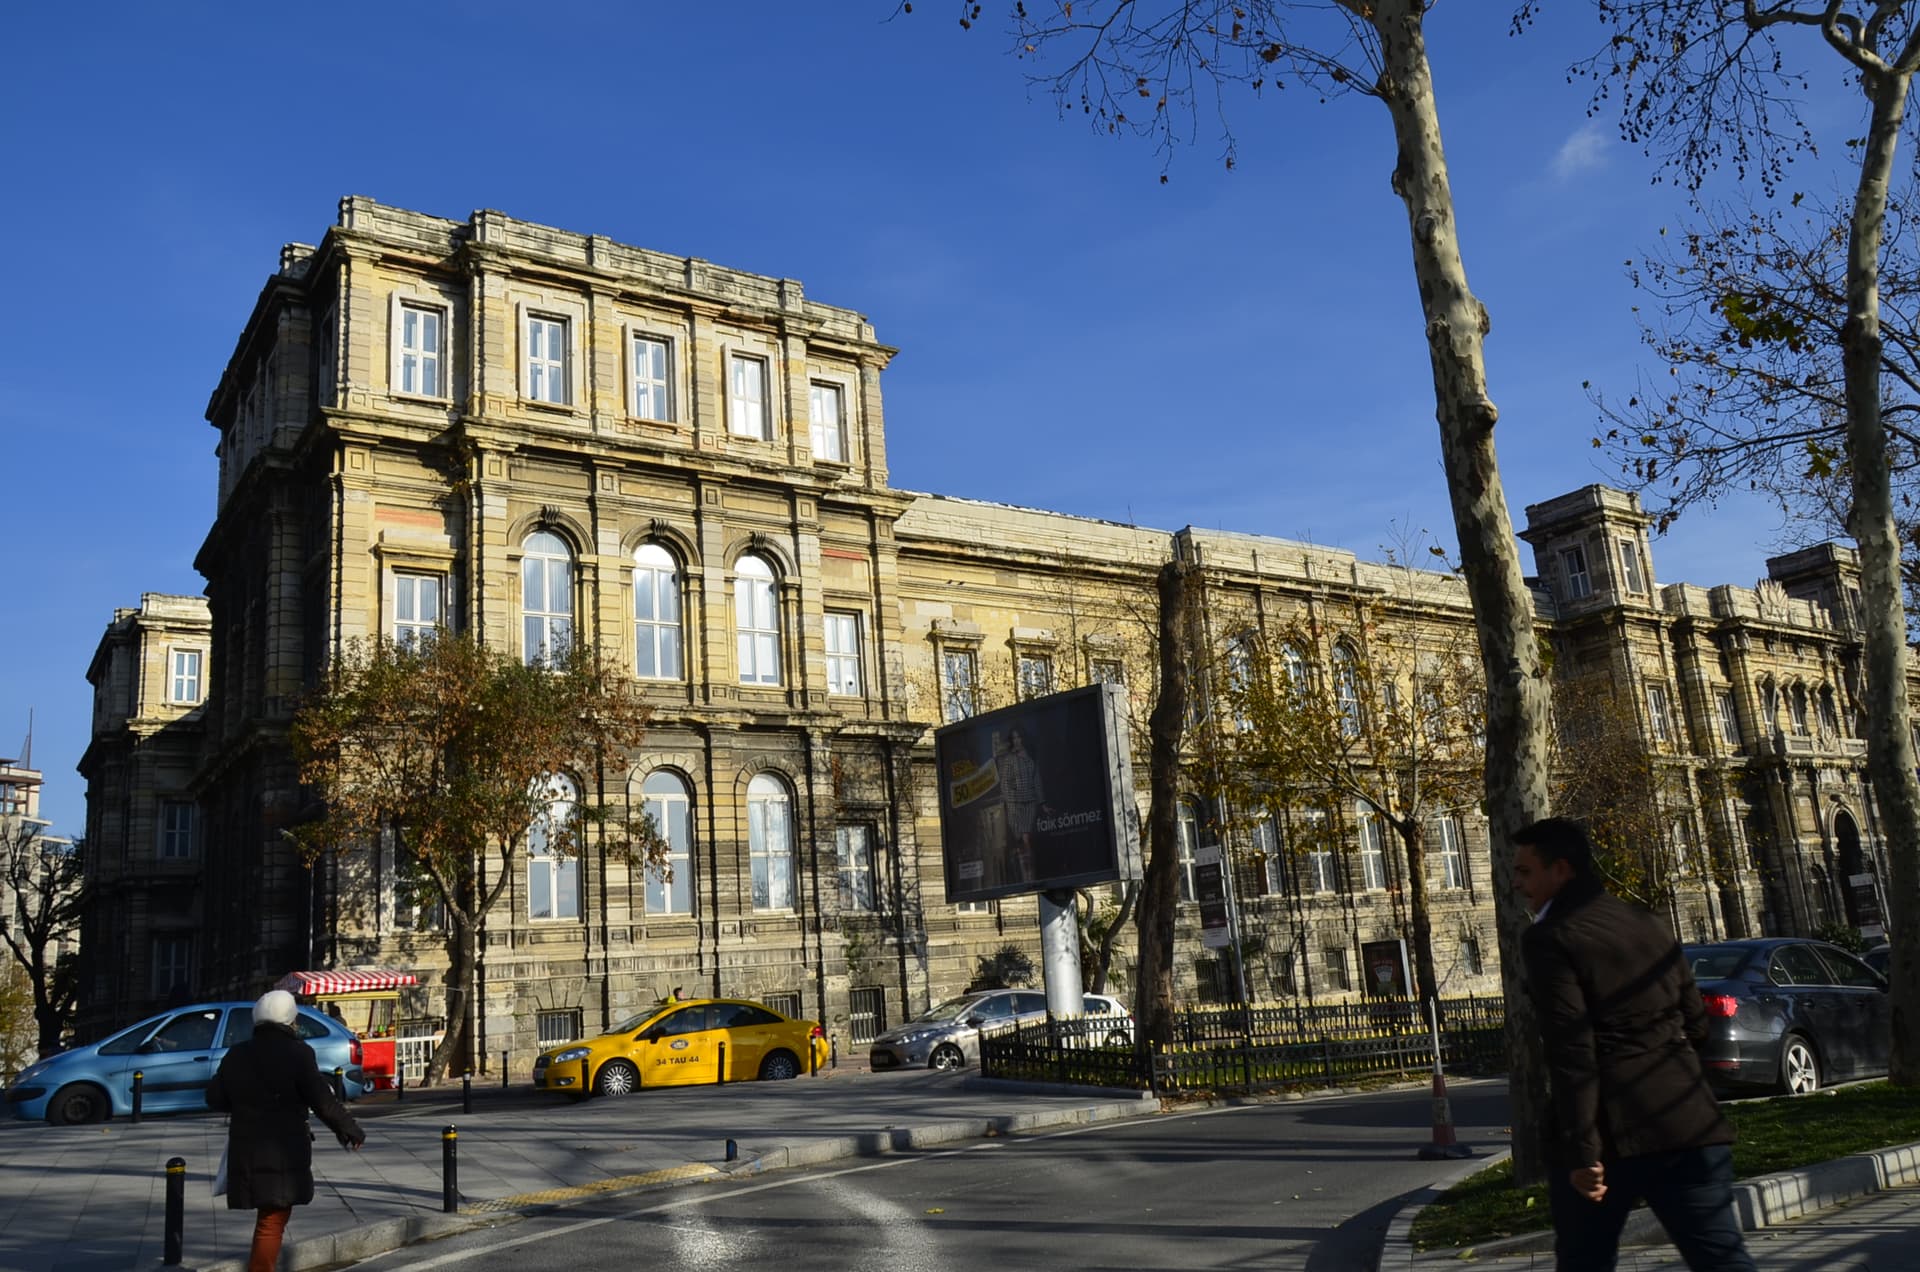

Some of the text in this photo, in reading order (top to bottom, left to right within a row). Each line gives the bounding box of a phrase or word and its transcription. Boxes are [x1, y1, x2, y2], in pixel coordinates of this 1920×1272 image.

[1036, 816, 1057, 832] faik
[1057, 810, 1103, 828] sönmez
[656, 1058, 667, 1066] 34
